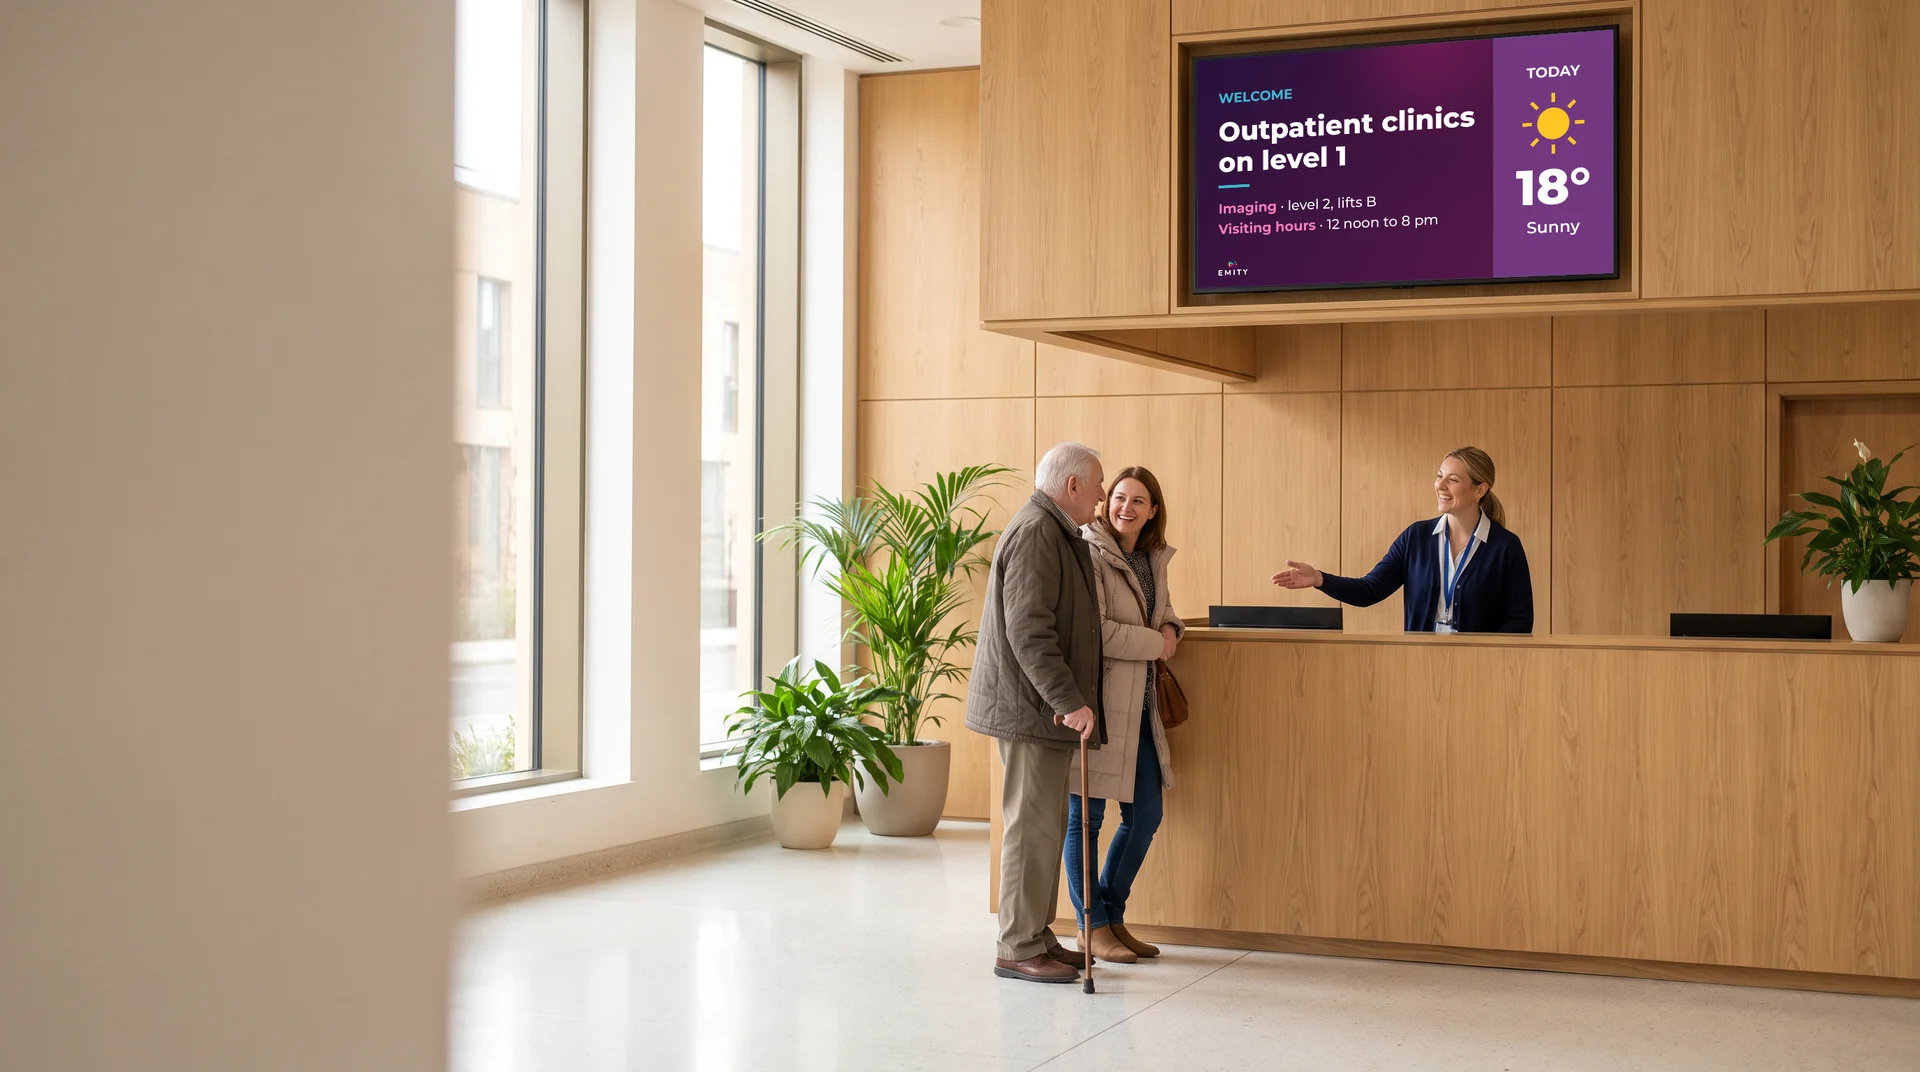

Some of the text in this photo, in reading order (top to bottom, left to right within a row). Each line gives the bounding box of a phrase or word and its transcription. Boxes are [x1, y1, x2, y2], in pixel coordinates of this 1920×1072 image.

[1526, 65, 1580, 78] TODAY
[1219, 89, 1292, 103] WELCOME
[1219, 106, 1475, 144] Outpatient clinics
[1219, 146, 1346, 172] on level 1
[1219, 201, 1276, 215] Imaging
[1288, 198, 1318, 210] level
[1323, 199, 1334, 211] 2,
[1338, 197, 1362, 208] lifts
[1367, 196, 1376, 207] B
[1219, 222, 1271, 235] Visiting
[1276, 221, 1316, 232] hours
[1327, 219, 1339, 229] 12
[1344, 219, 1379, 228] noon
[1383, 217, 1397, 227] to
[1402, 216, 1410, 226] 8
[1415, 216, 1438, 228] pm
[1527, 222, 1580, 235] Sunny
[1217, 268, 1249, 277] EMITY
